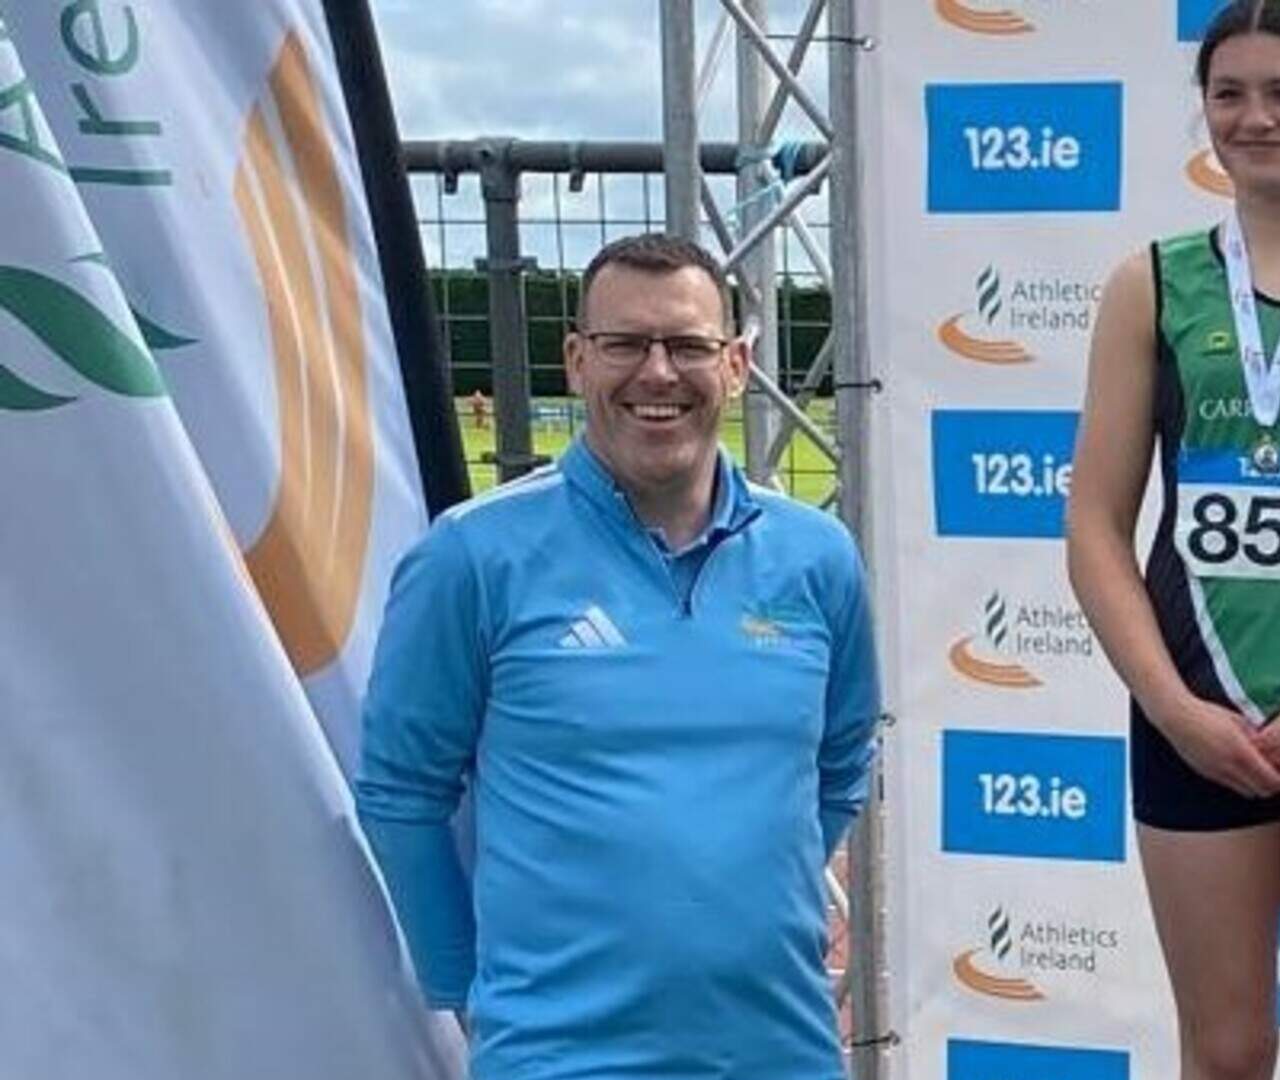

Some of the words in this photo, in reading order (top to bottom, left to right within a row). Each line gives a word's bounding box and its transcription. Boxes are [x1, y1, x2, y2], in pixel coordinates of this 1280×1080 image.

[964, 127, 1080, 170] 123.ie
[1010, 279, 1101, 302] Athletic
[1010, 307, 1089, 330] Ireland
[1017, 632, 1092, 656] Ireland
[979, 774, 1087, 819] 123.ie
[1020, 922, 1118, 949] Athletics
[1020, 950, 1096, 973] Ireland
